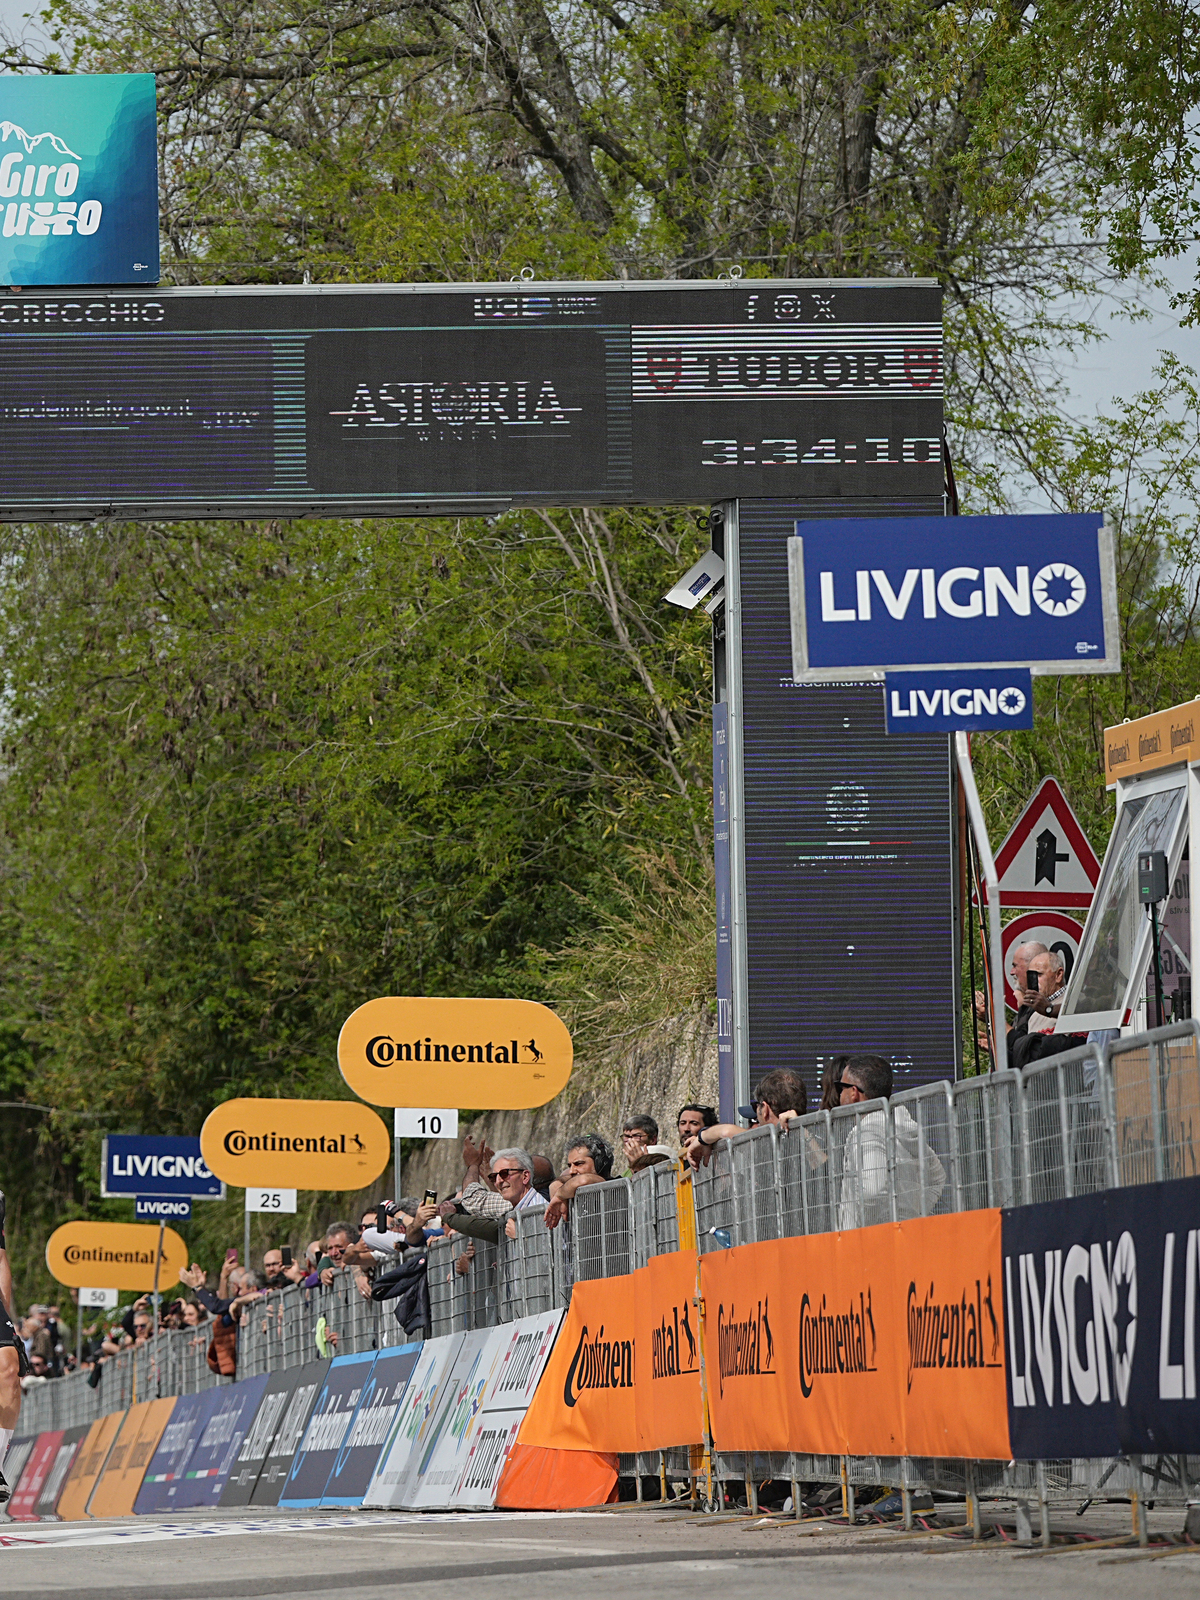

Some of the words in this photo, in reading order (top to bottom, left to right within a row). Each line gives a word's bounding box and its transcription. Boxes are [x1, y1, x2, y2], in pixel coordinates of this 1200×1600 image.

[820, 563, 1087, 622] LIVIGNO
[891, 687, 1026, 717] LIVIGNO
[365, 1035, 520, 1068] Continental
[417, 1116, 442, 1134] 10
[223, 1130, 347, 1156] Continental
[136, 1202, 190, 1215] LIVIGNO
[260, 1193, 281, 1208] 25
[63, 1245, 155, 1264] Continental
[90, 1291, 105, 1302] 50
[1005, 1231, 1138, 1407] LIVIGNO
[799, 1292, 868, 1398] Continental
[907, 1280, 985, 1395] Continental
